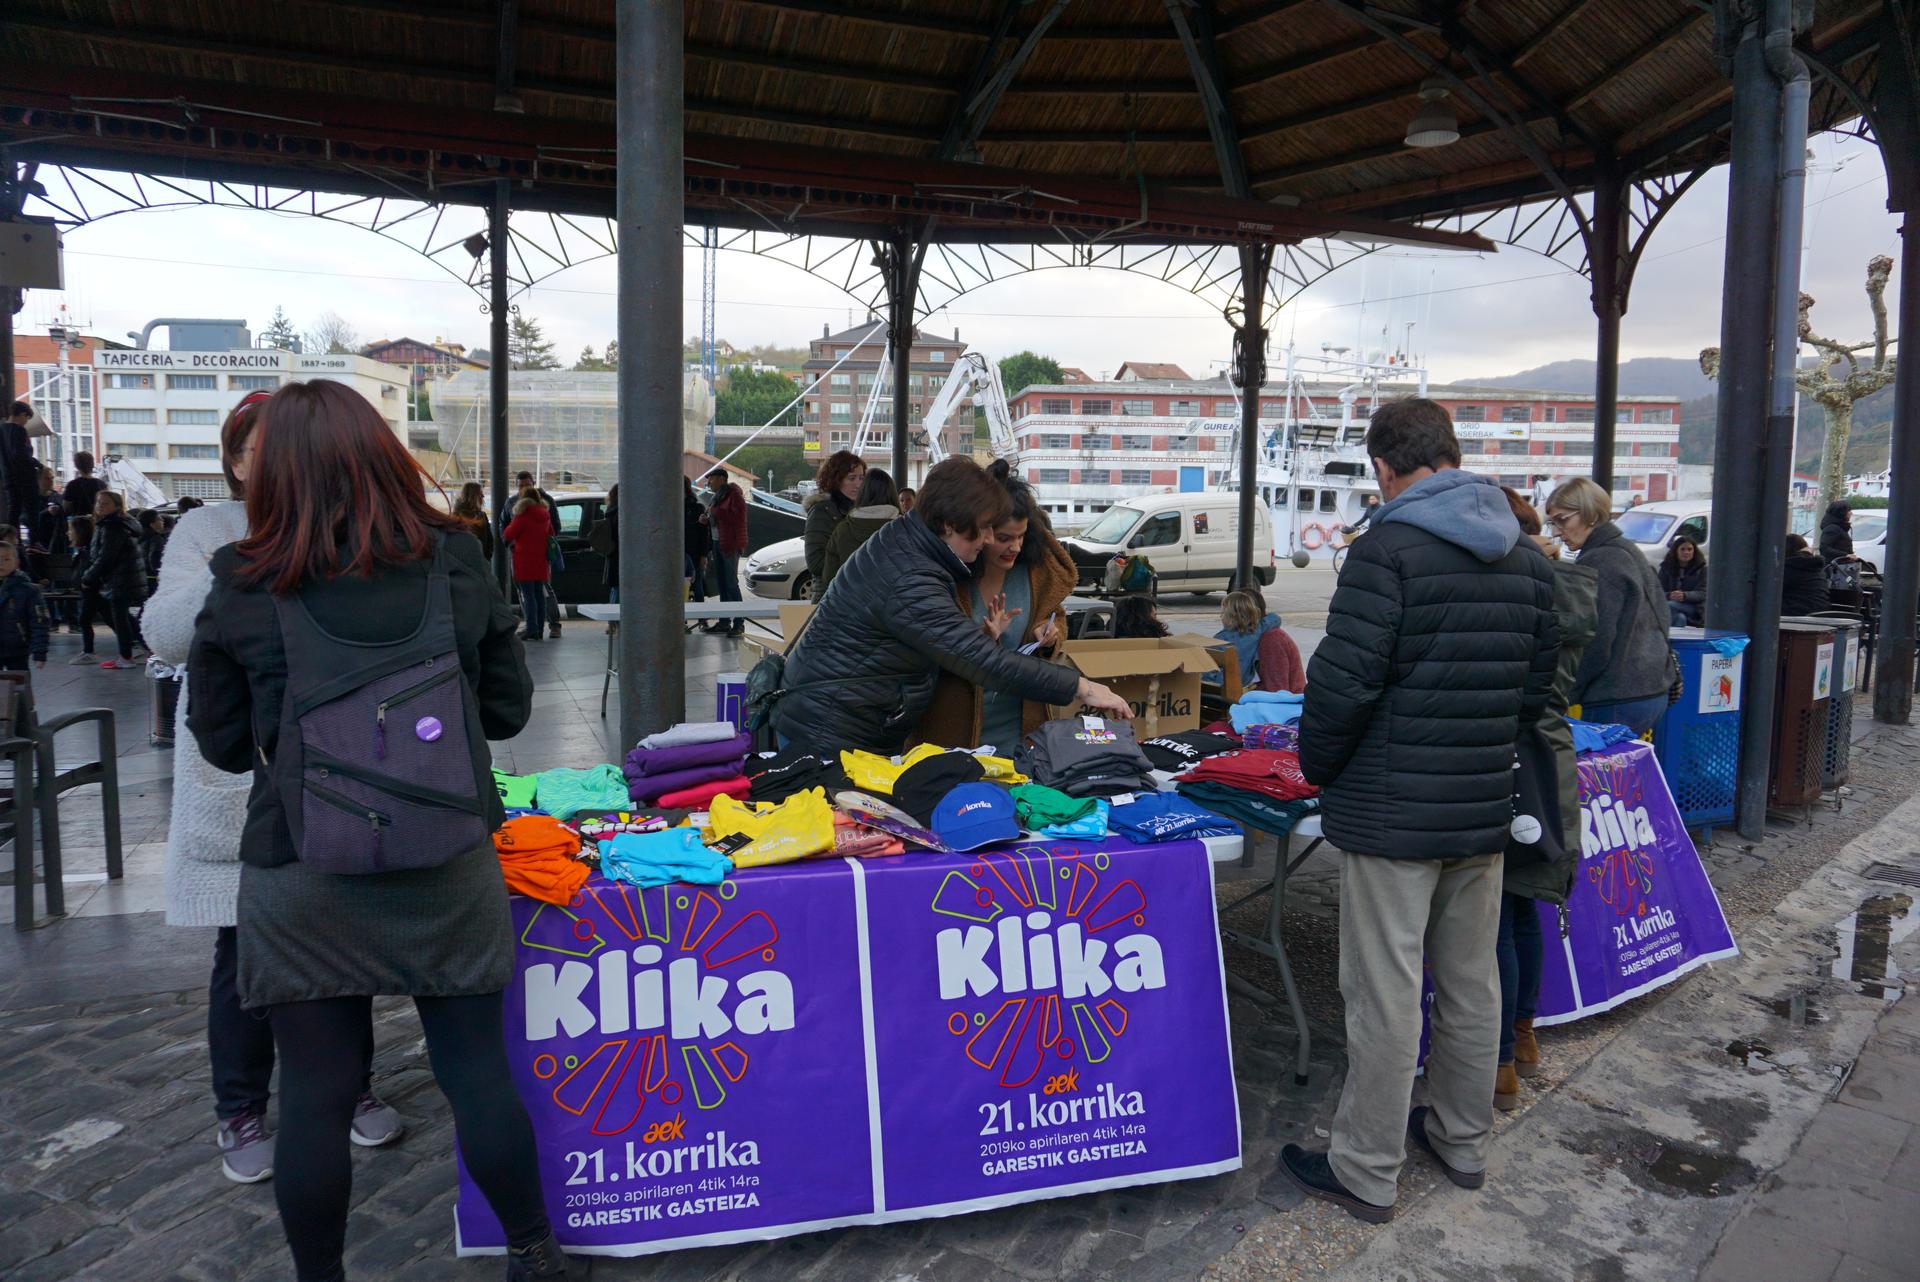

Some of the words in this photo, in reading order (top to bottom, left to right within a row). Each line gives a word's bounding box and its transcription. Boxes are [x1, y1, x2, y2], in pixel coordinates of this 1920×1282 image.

[102, 353, 173, 366] TAPICERIA
[193, 355, 279, 367] DECORACION
[1456, 430, 1495, 438] NSERBAK
[1711, 659, 1733, 670] PAPERA
[936, 911, 1167, 1000] Klika
[525, 945, 795, 1040] Klika
[1043, 1065, 1080, 1095] aek
[978, 1100, 1025, 1136] 21.
[1029, 1083, 1146, 1128] korrika
[643, 1112, 687, 1144] aek
[980, 1141, 1026, 1157] 2019ko
[1029, 1132, 1089, 1151] apirilaren
[1093, 1127, 1118, 1140] 4tik
[1121, 1124, 1146, 1136] 14ra
[564, 1148, 620, 1186] 21.
[625, 1131, 761, 1180] korrika
[982, 1152, 1064, 1176] GARESTIK
[1067, 1140, 1147, 1164] GASTEIZA
[565, 1191, 620, 1208] 2019ko
[624, 1182, 694, 1202] apirilaren
[698, 1177, 726, 1191] 4tik
[730, 1174, 760, 1188] 14ra
[567, 1205, 663, 1228] GARESTIK
[667, 1192, 760, 1218] GASTEIZA
